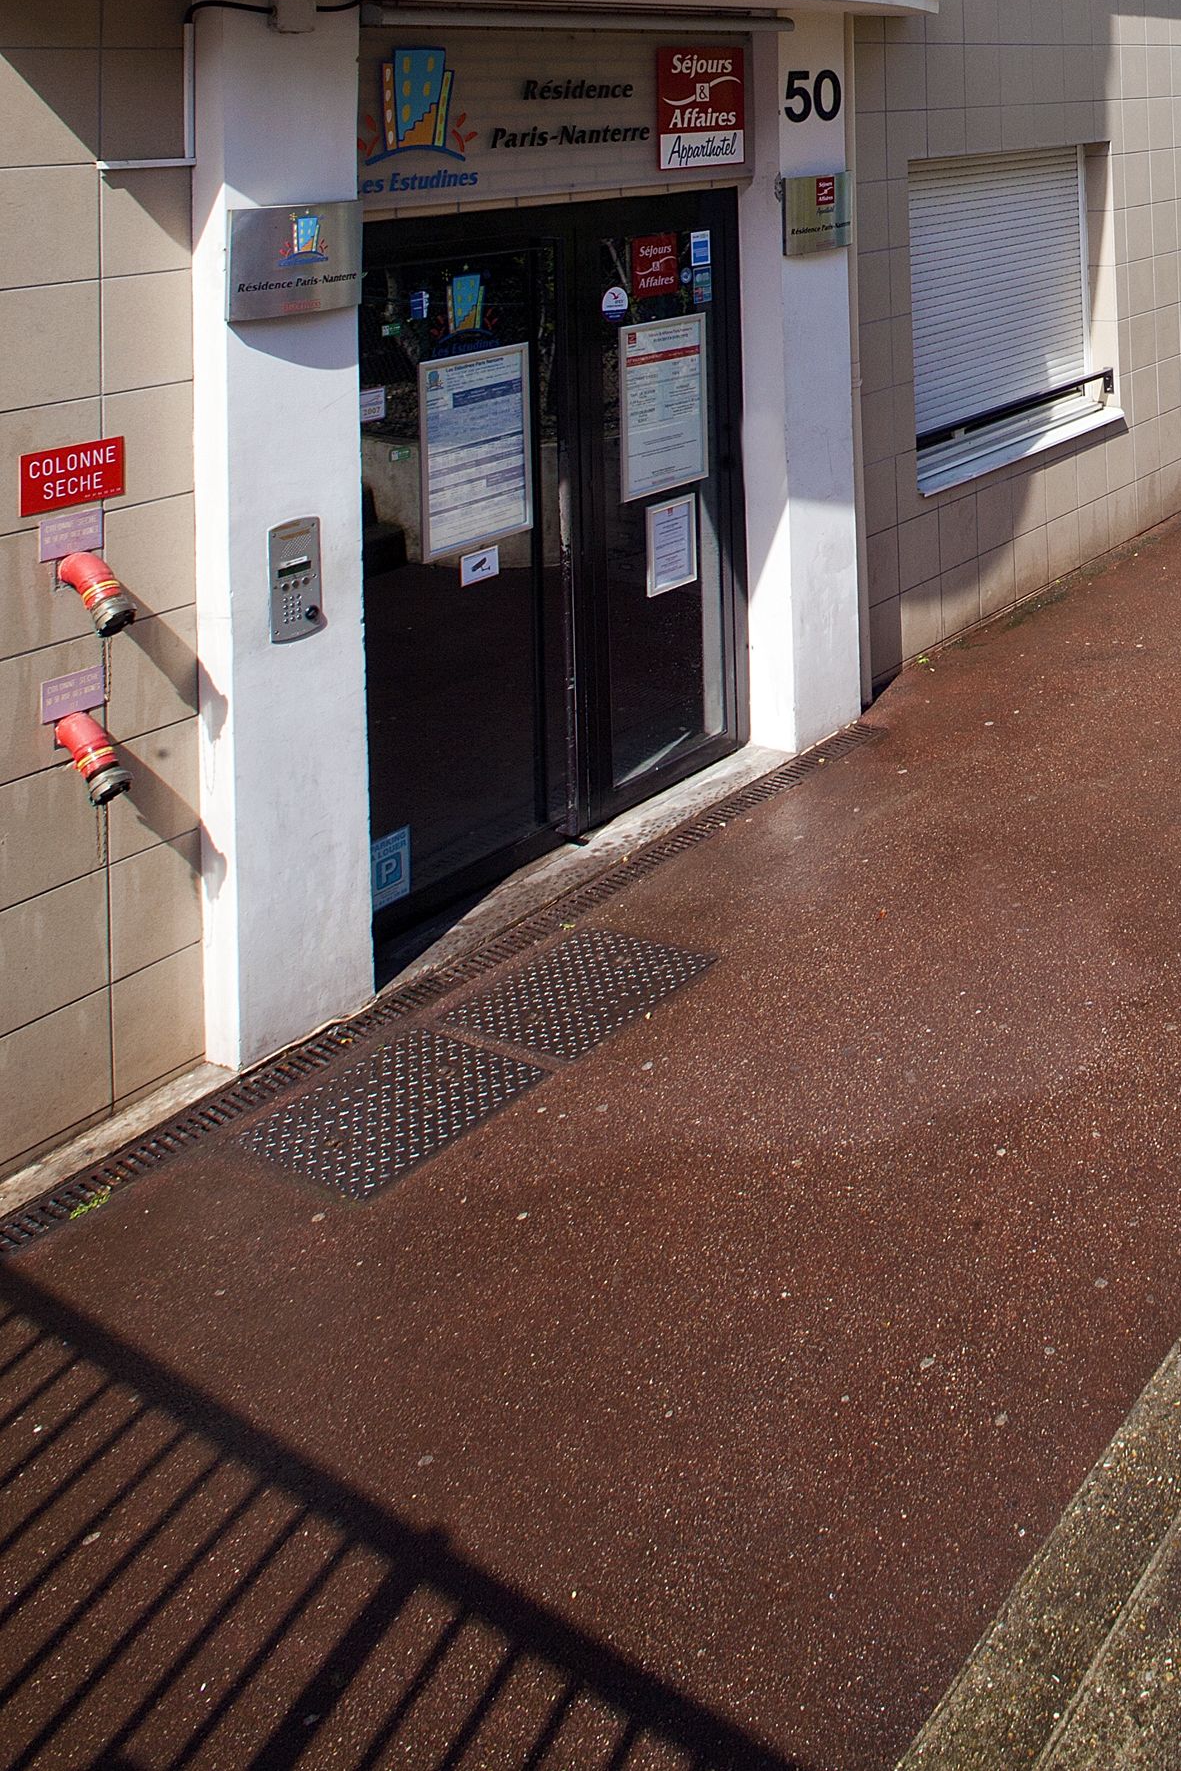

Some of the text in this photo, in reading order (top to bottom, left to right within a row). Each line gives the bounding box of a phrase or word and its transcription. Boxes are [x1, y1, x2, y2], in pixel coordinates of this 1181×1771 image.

[671, 54, 733, 79] Séjours
[523, 79, 633, 101] Résidence
[700, 84, 709, 101] &
[784, 69, 842, 123] 50
[669, 108, 737, 129] Affaires
[491, 125, 650, 149] Paris-Nanterre
[667, 132, 738, 166] Apparthotel
[357, 169, 478, 194] es Estudines
[639, 245, 672, 258] Séjours
[237, 272, 357, 293] Résidence Paris-Nanterre
[639, 275, 675, 289] Affaires
[29, 445, 116, 479] COLONNE
[43, 471, 103, 500] SECHE
